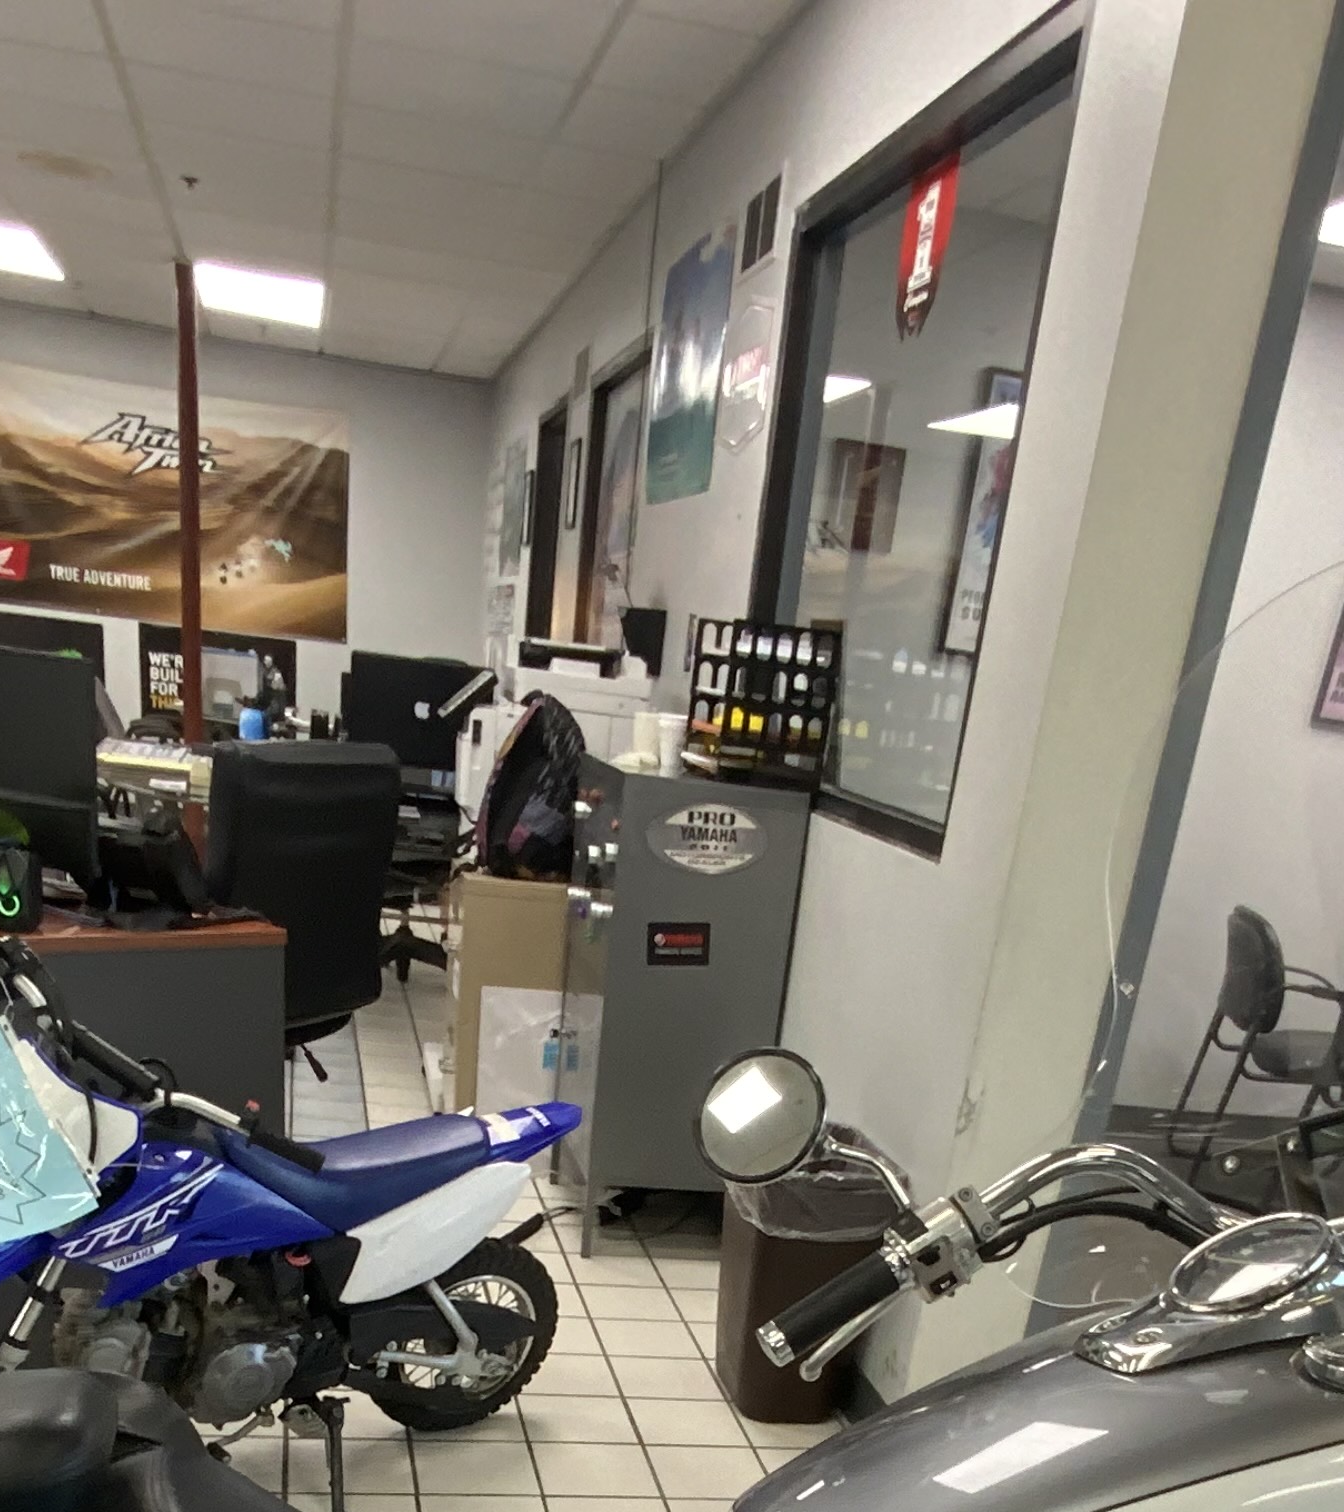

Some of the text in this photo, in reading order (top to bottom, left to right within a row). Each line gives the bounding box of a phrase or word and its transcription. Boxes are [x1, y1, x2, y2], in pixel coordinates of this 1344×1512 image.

[49, 563, 152, 591] TRUE ADVENTURE
[148, 651, 184, 668] WE'R
[150, 666, 184, 684] BUIL
[150, 681, 179, 697] FOR
[688, 811, 736, 826] PRO
[681, 826, 737, 843] YAMAHA
[112, 1246, 155, 1268] YAMAHA
